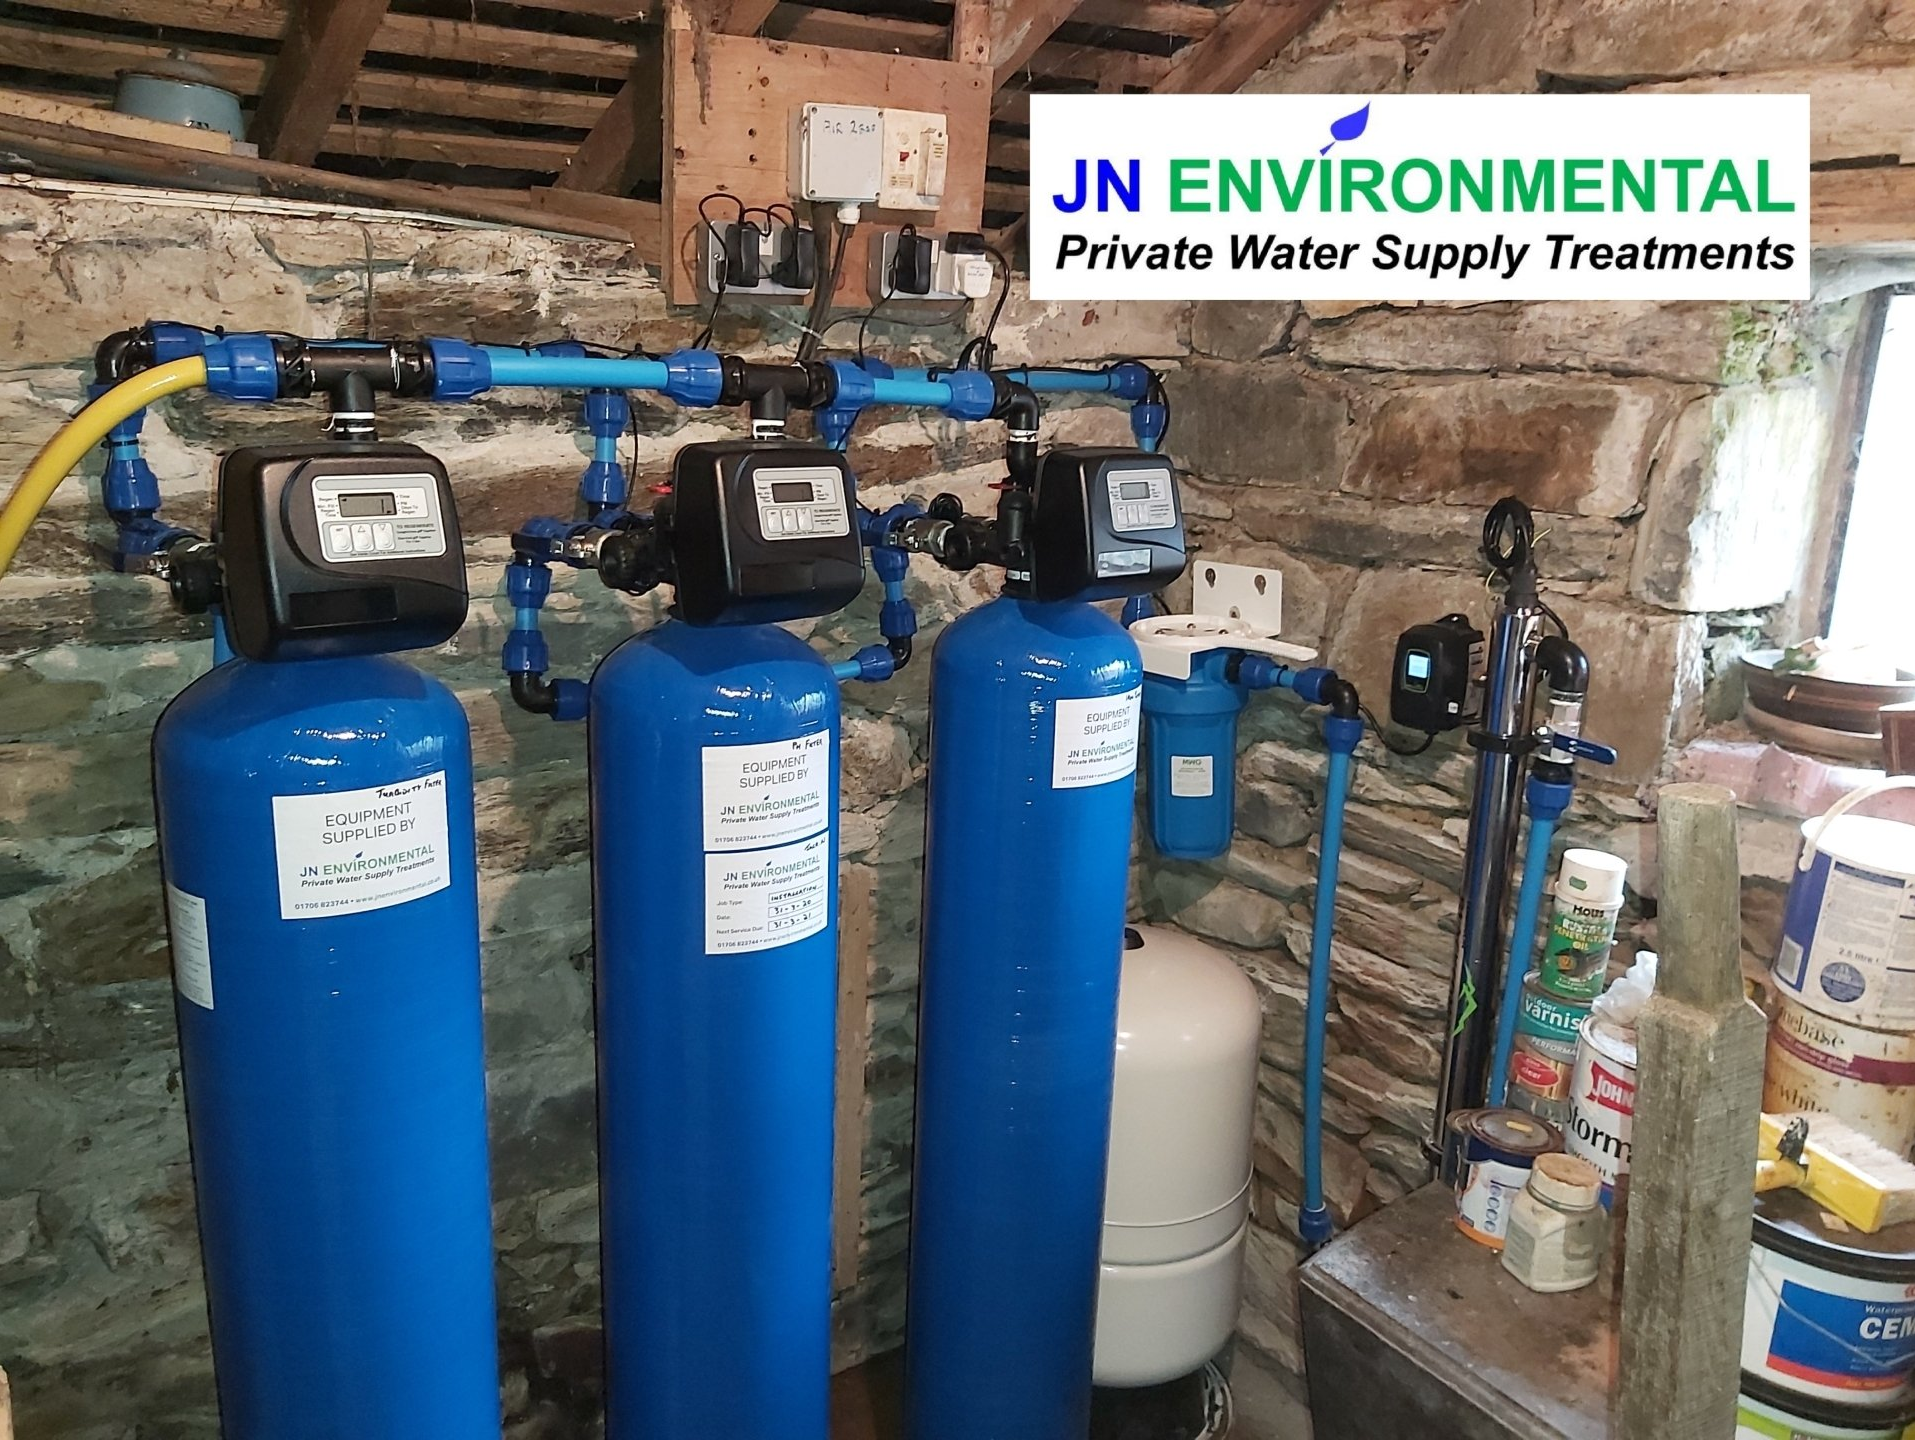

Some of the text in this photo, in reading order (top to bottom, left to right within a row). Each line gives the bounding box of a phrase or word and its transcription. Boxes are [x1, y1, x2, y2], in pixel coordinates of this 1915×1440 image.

[1087, 706, 1130, 723] EQUIPMENT
[1084, 721, 1122, 735] SUPPLIED
[742, 754, 807, 773] EQUIPMENT
[1068, 750, 1079, 758] JN
[739, 768, 809, 788] SUPPLIED BY
[325, 801, 412, 827] EQUIPMENT
[720, 790, 820, 815] JN ENVIRONMENTAL
[721, 816, 746, 824] Private
[748, 814, 768, 822] Water
[770, 810, 792, 819] Supply
[322, 817, 416, 845] SUPPLIED BY
[300, 844, 435, 877] JN ENVIRONMENTAL
[301, 857, 435, 887] Private Water Supply Treatments
[723, 855, 820, 882] JN ENVIRONMENTAL
[750, 880, 770, 888] Water
[771, 876, 793, 885] Supply
[294, 902, 319, 910] 01706
[1525, 998, 1584, 1031] varnis
[1779, 1007, 1844, 1048] mebase
[1531, 1036, 1576, 1056] PERFORMA
[1592, 1074, 1634, 1108] JOHN
[1566, 1096, 1632, 1164] Storm
[1859, 1316, 1915, 1340] CEM
